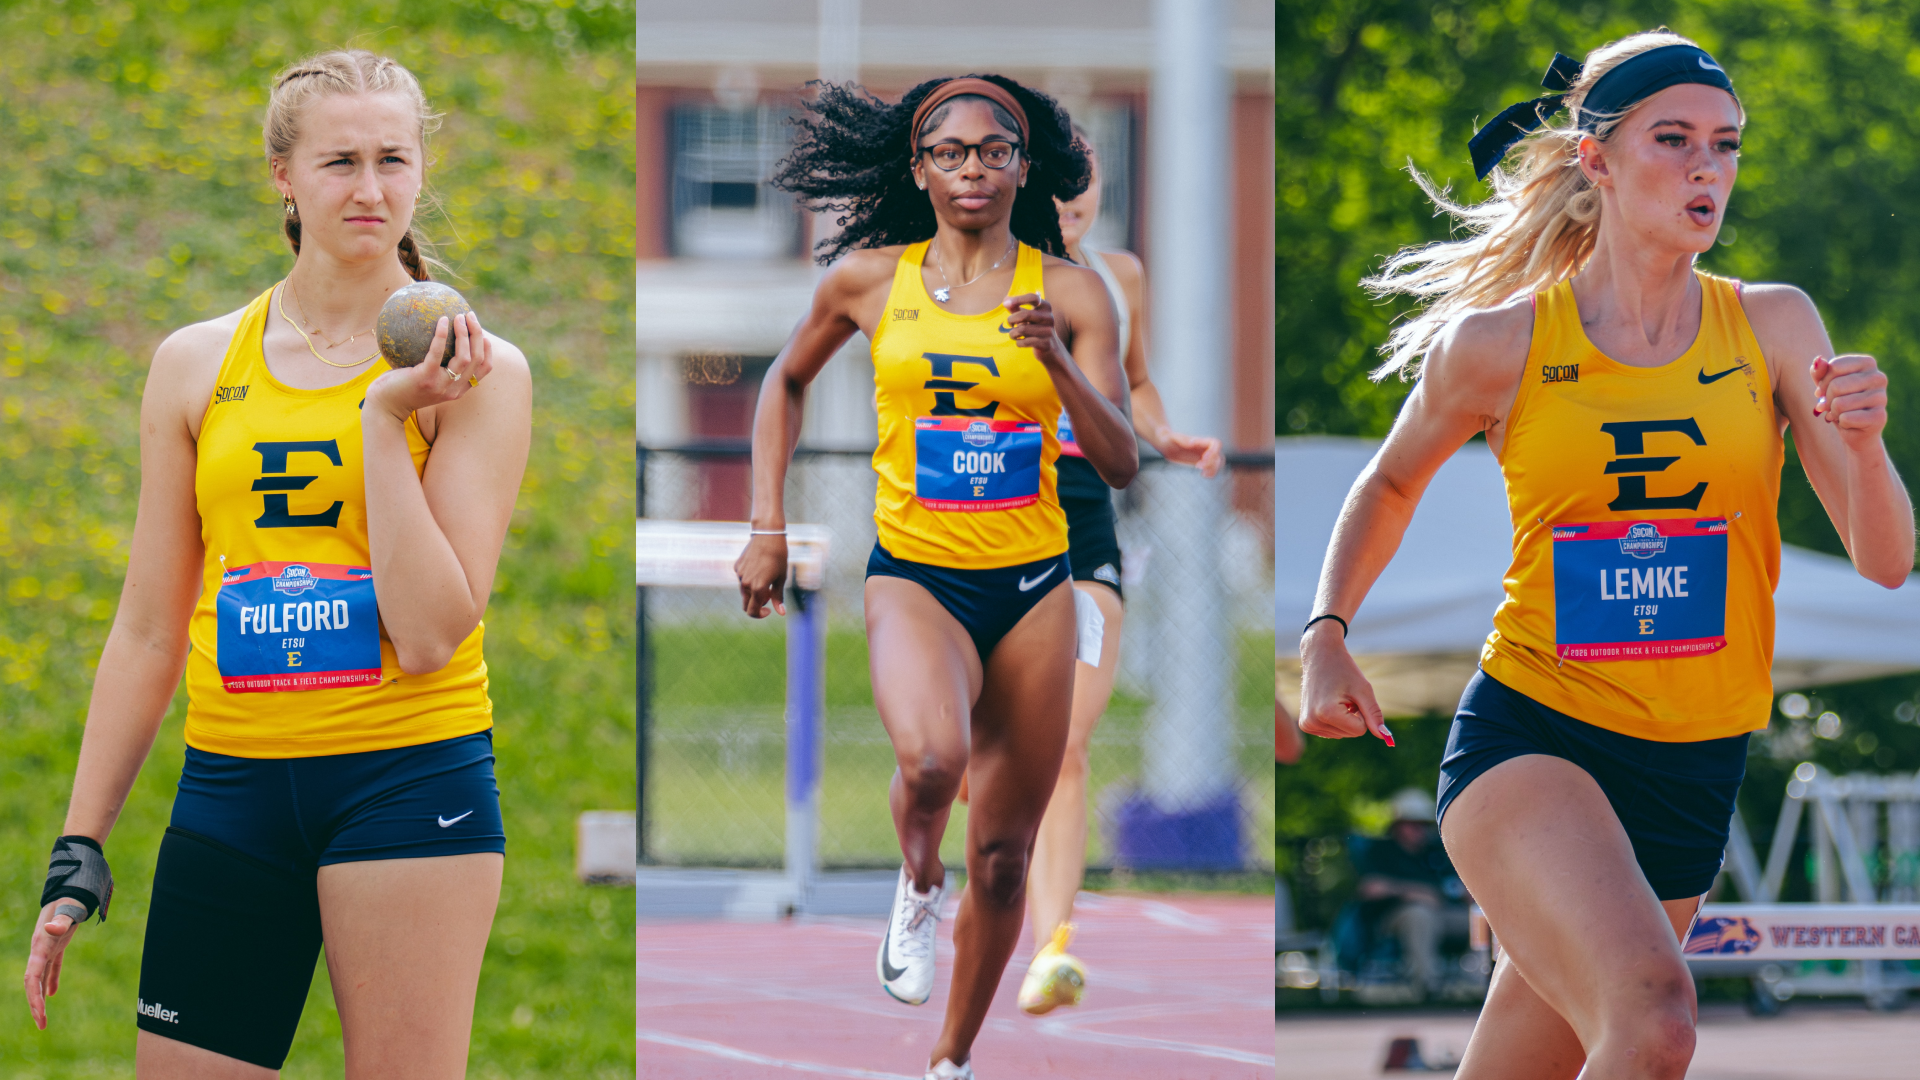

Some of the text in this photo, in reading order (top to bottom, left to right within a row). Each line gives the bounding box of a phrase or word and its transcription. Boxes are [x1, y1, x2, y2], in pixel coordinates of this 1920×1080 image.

[921, 352, 1001, 419] E
[953, 450, 1006, 474] COOK
[1599, 416, 1709, 512] E
[251, 438, 345, 529] E
[969, 476, 988, 485] ETSU
[1622, 541, 1664, 550] CHAMPIONSHIPS
[275, 580, 314, 588] CHAMPIONSHIPS
[1600, 566, 1689, 600] LEMKE
[240, 600, 350, 635] FULFORD
[1633, 604, 1659, 616] ETSU
[281, 637, 305, 649] ETSU
[1570, 649, 1588, 657] 2026
[1590, 648, 1620, 656] OUTDOOR
[1622, 647, 1643, 655] TRACK
[1651, 645, 1669, 654] FIELD
[1670, 642, 1715, 653] CHAMPIONSHIPS
[246, 680, 271, 688] OUTDOOR
[272, 679, 291, 687] TRACK
[300, 677, 317, 685] FIELD
[319, 673, 370, 685] CHAMPIONSHIPS
[1770, 925, 1885, 947] WESTERN
